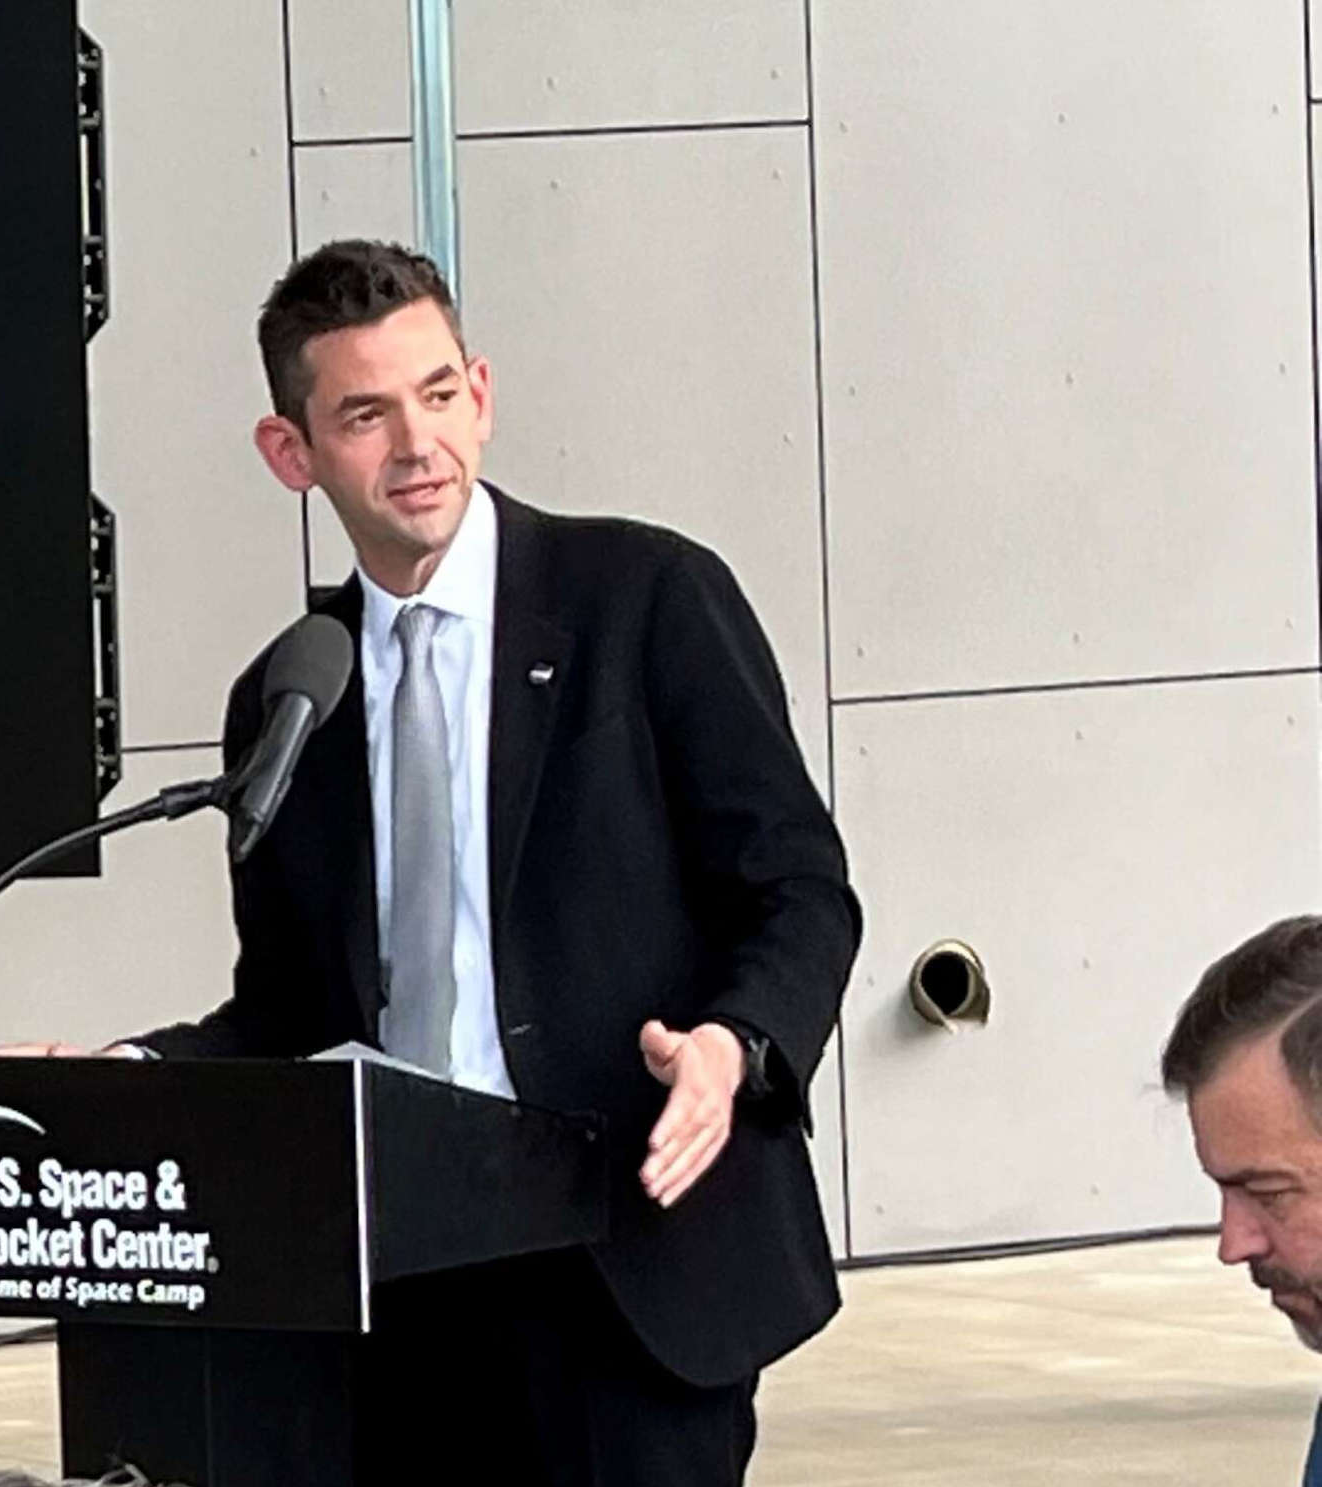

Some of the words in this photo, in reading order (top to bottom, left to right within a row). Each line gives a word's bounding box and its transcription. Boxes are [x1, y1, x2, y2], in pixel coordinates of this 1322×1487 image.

[38, 1158, 148, 1219] Space
[155, 1159, 187, 1210] &
[36, 1275, 62, 1299] of
[65, 1276, 134, 1307] Space
[137, 1279, 206, 1311] Camp
